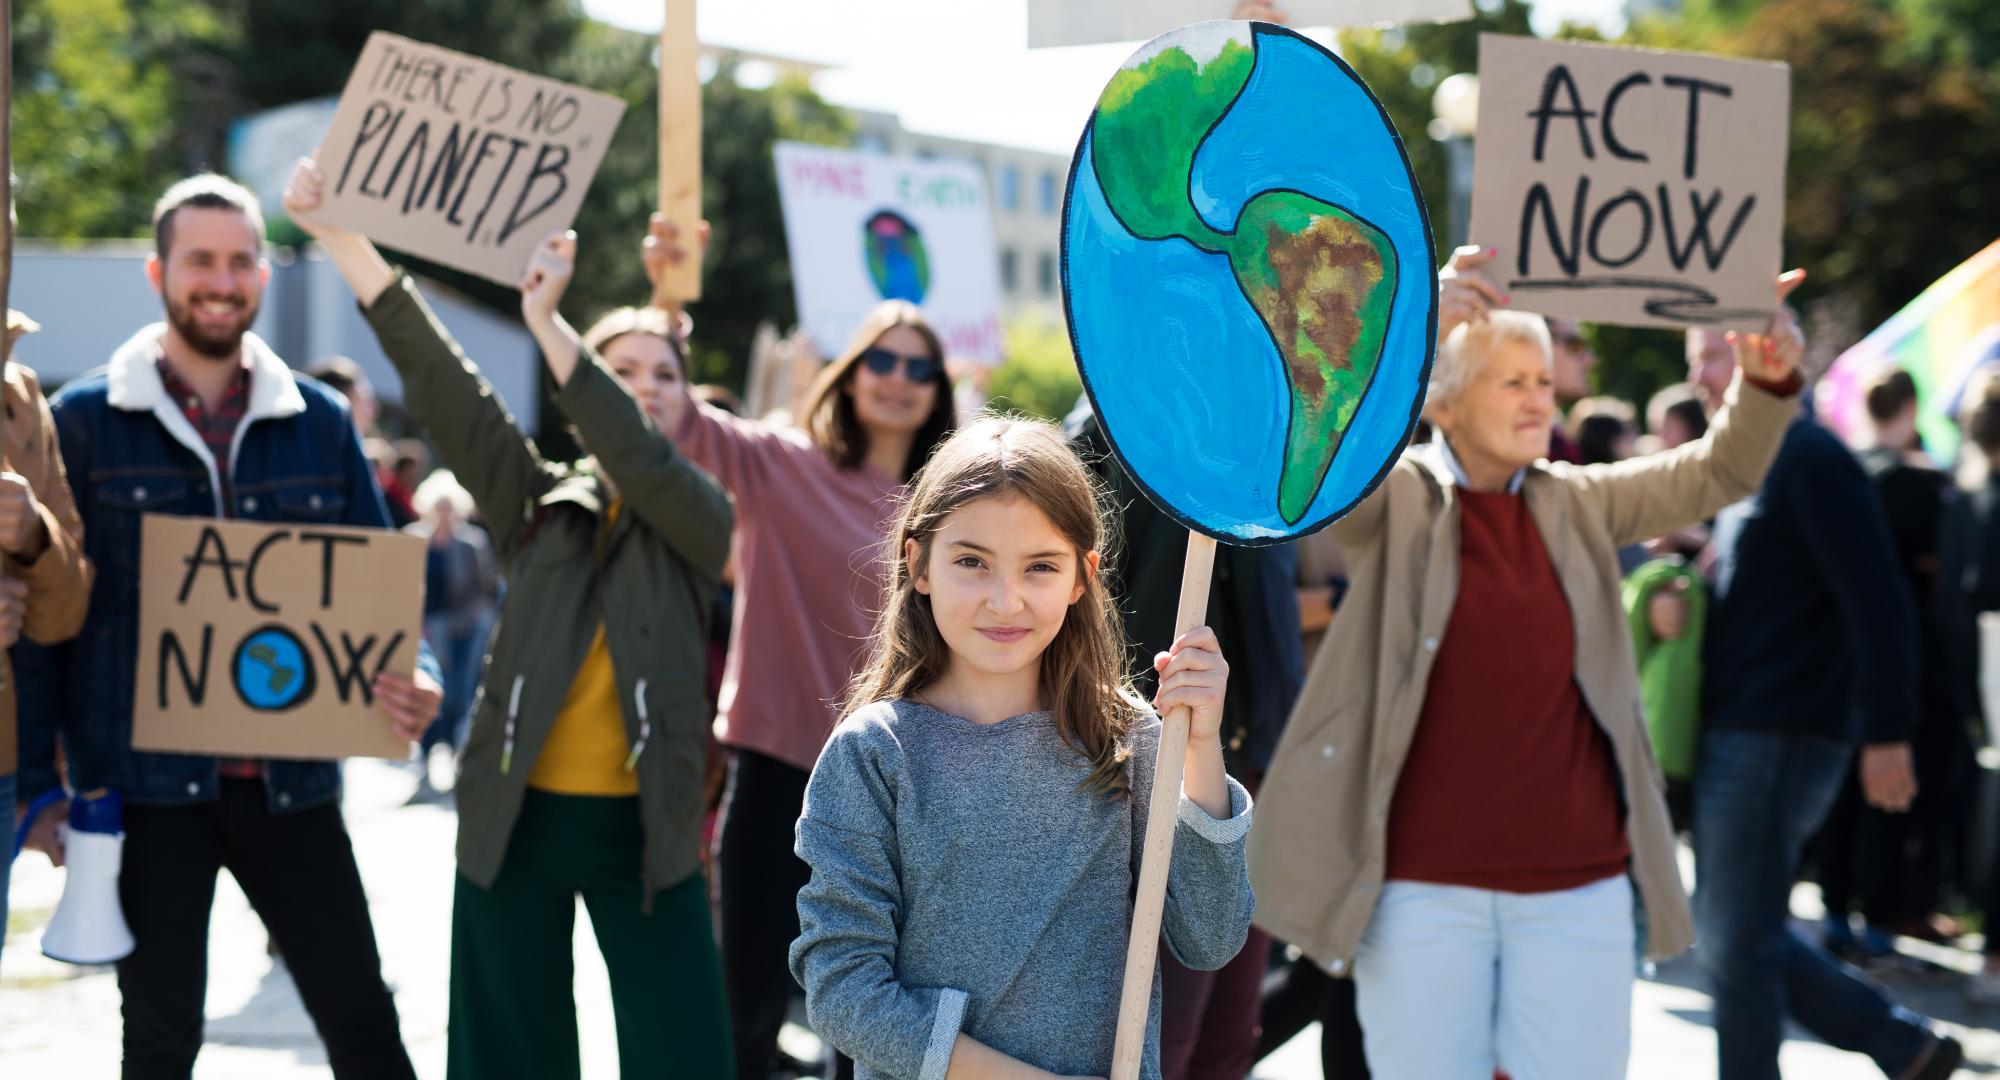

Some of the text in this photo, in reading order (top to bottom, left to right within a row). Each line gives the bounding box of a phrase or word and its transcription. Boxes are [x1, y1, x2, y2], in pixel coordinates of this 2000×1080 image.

[368, 43, 580, 134] THERE IS NO
[1526, 64, 1733, 180] ACT
[335, 100, 529, 244] PLANET
[1517, 174, 1757, 277] NOW
[177, 525, 369, 614] ACT
[158, 621, 406, 712] NOW
